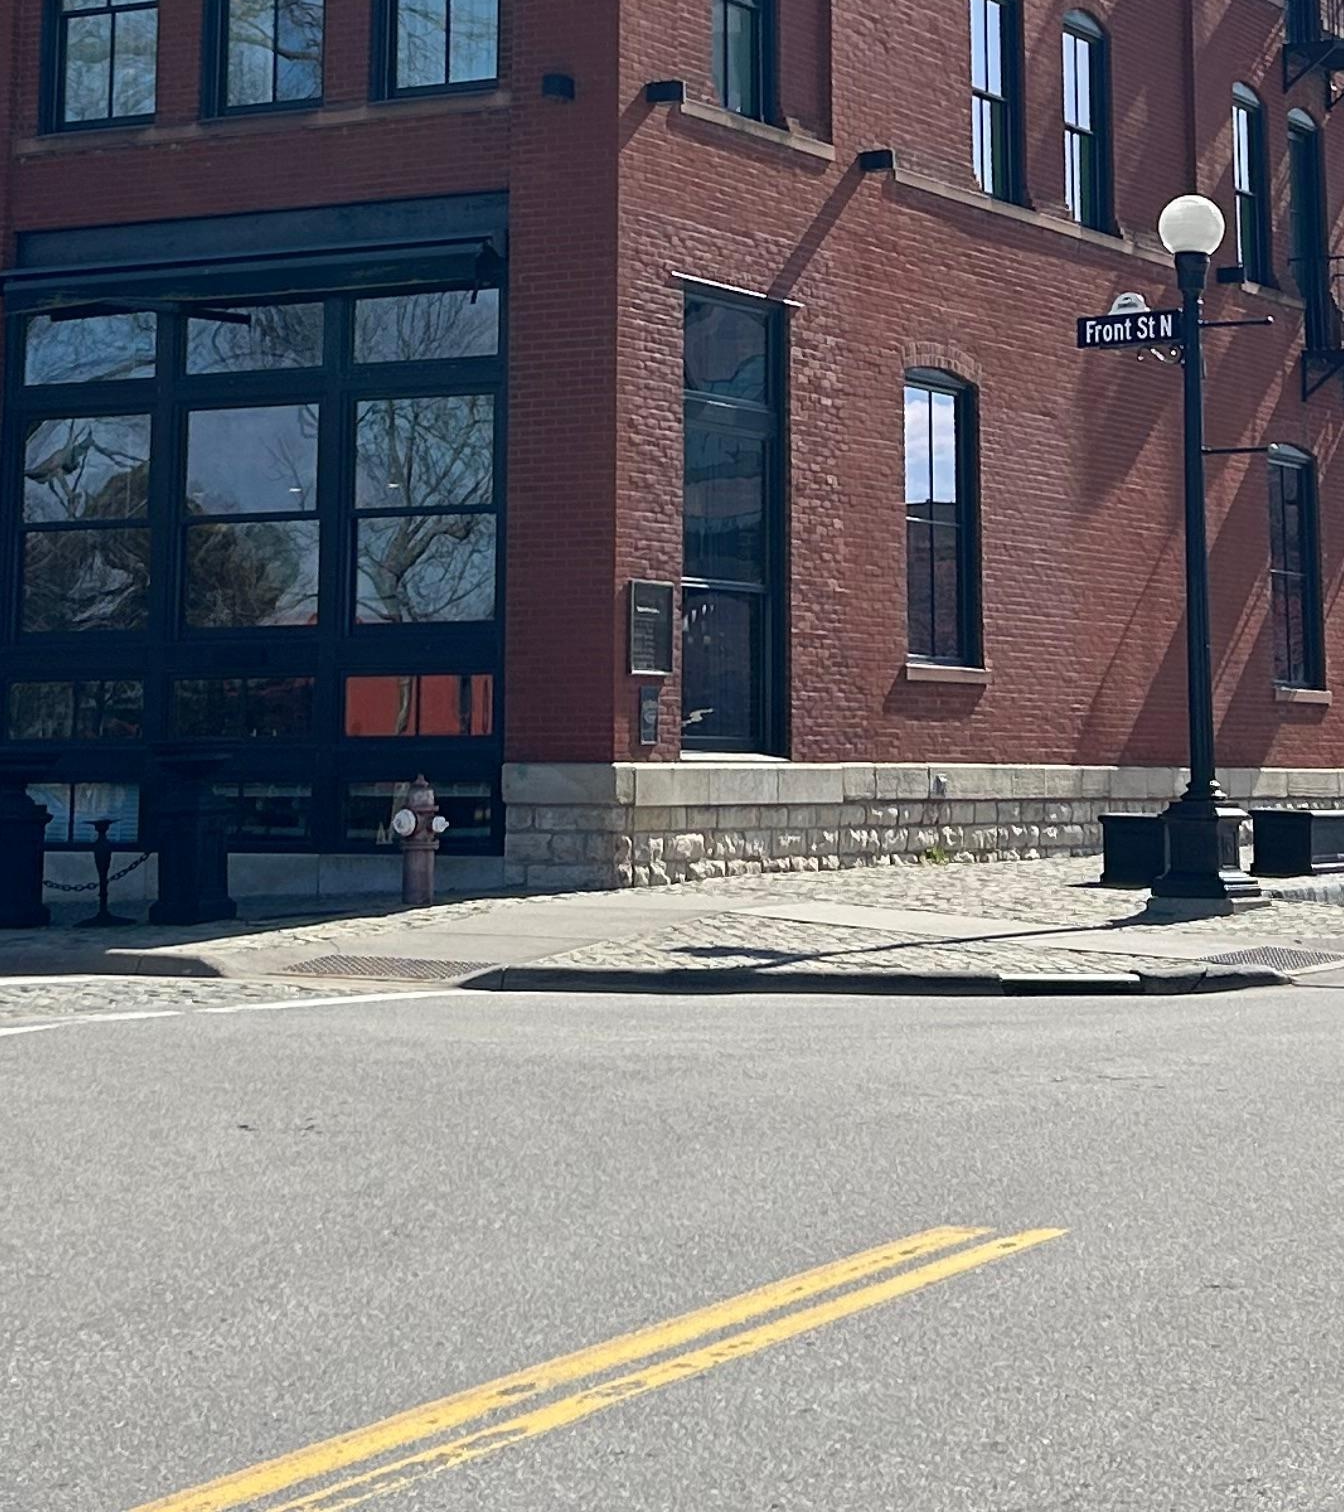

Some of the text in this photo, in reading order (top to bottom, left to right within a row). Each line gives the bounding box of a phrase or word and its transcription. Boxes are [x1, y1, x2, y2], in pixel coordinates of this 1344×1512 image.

[1085, 314, 1172, 344] Front St N
